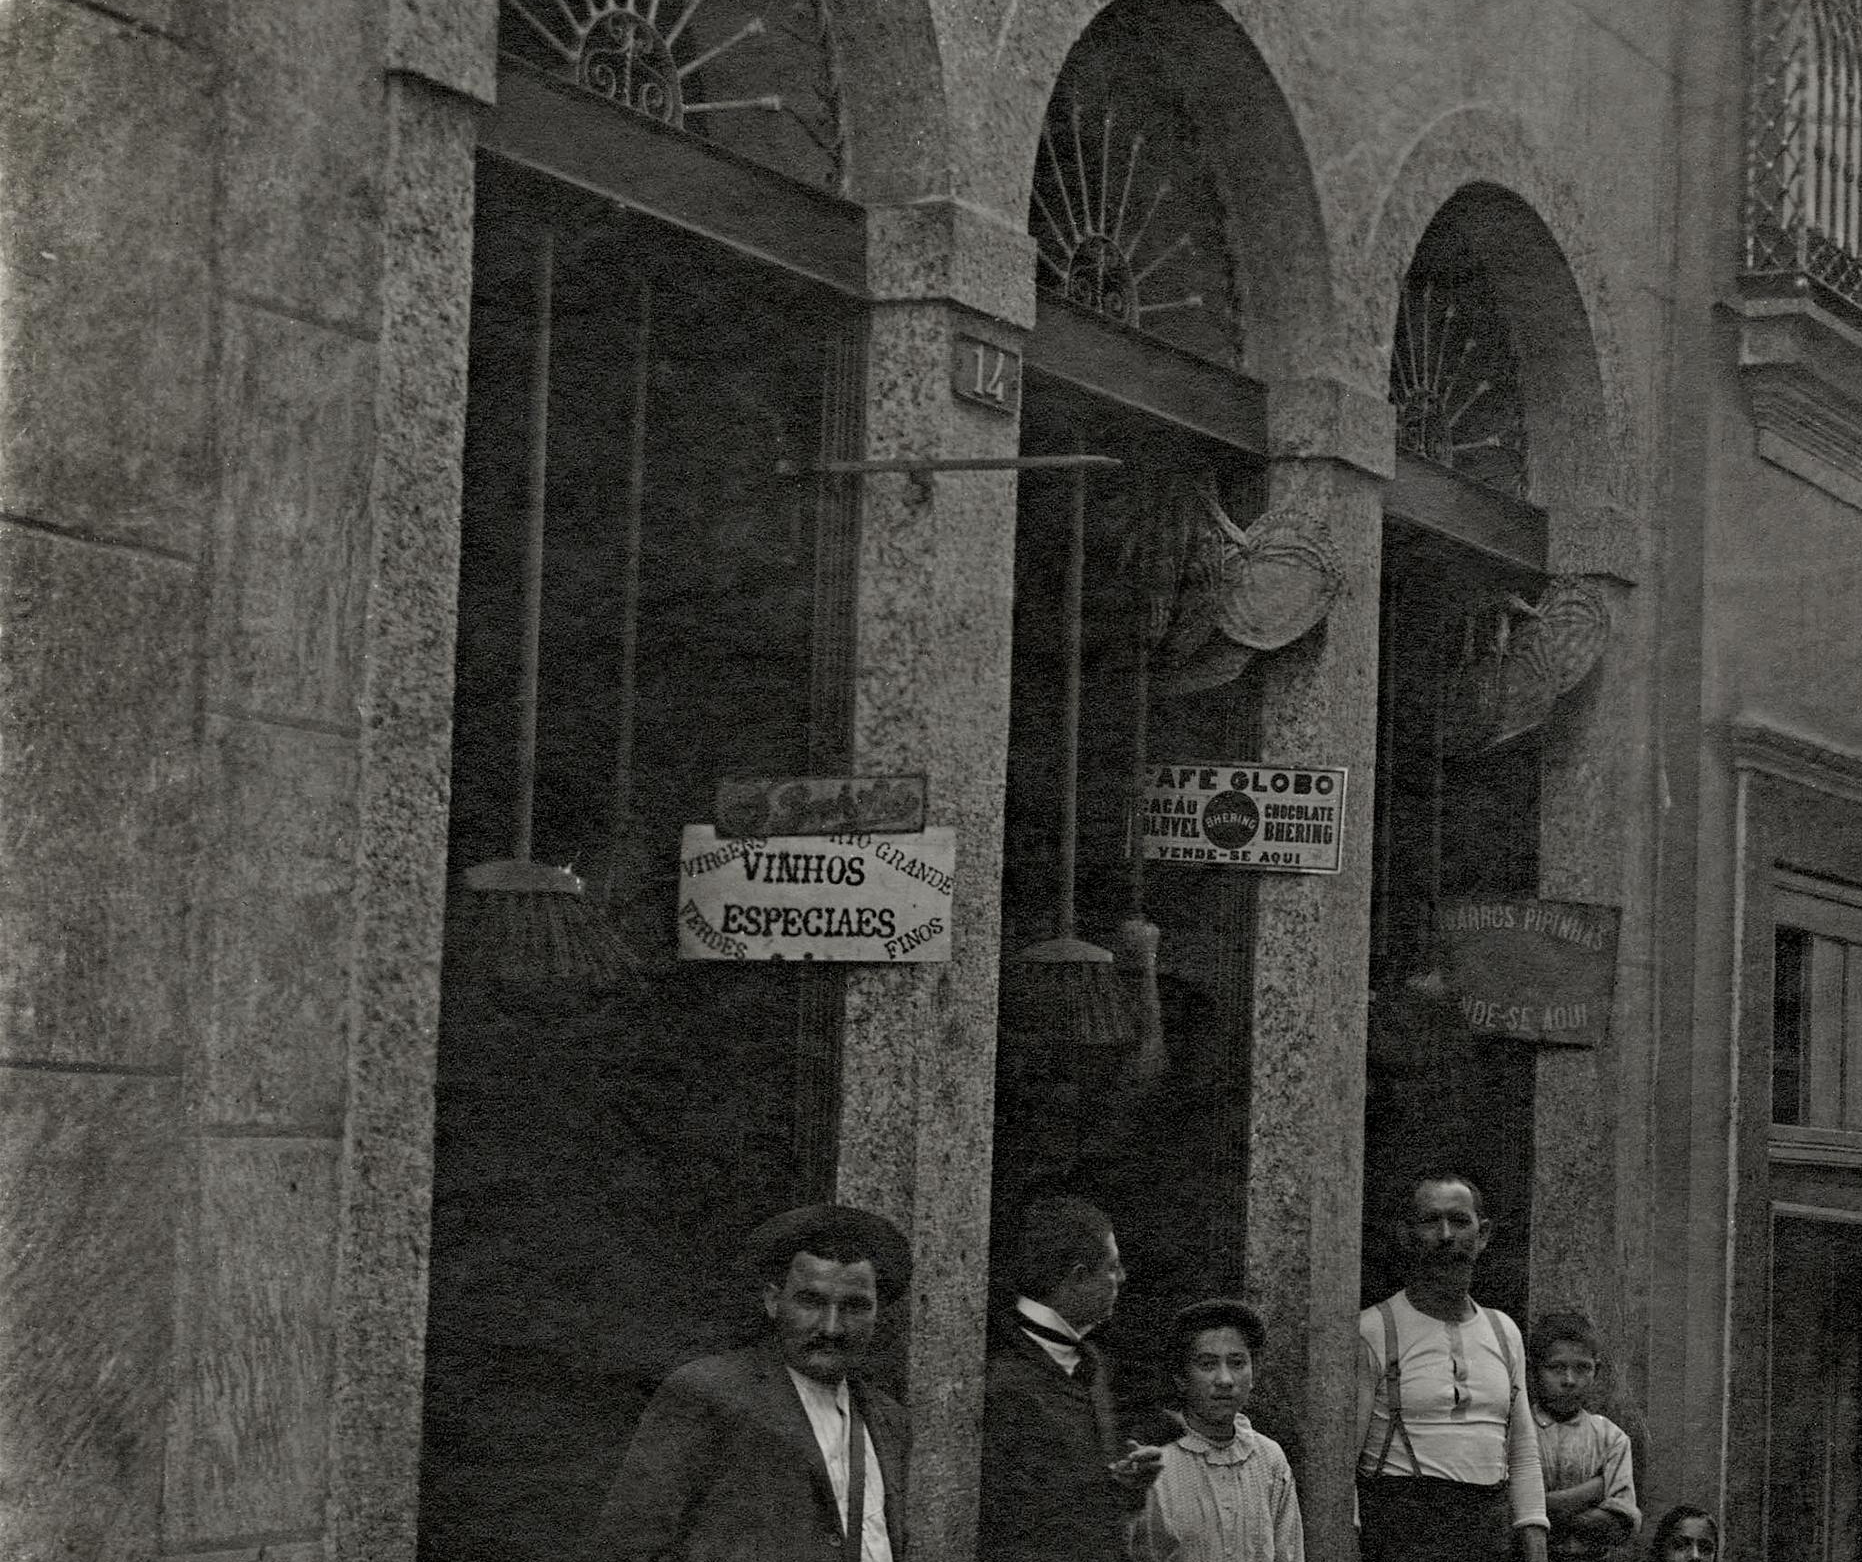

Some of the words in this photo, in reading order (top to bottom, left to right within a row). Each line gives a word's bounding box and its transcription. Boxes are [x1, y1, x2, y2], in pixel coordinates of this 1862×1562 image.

[972, 344, 1005, 402] 14
[1230, 770, 1335, 795] GLOBO
[1264, 803, 1335, 823] CHOCOLATE
[1263, 822, 1334, 846] BHERING
[742, 850, 866, 886] VINHOS
[875, 841, 954, 896] GRANDE
[1157, 845, 1252, 863] VENDE-SE
[1259, 850, 1301, 867] AQUI
[721, 903, 897, 938] ESPECIAES
[884, 917, 944, 960] FINOS
